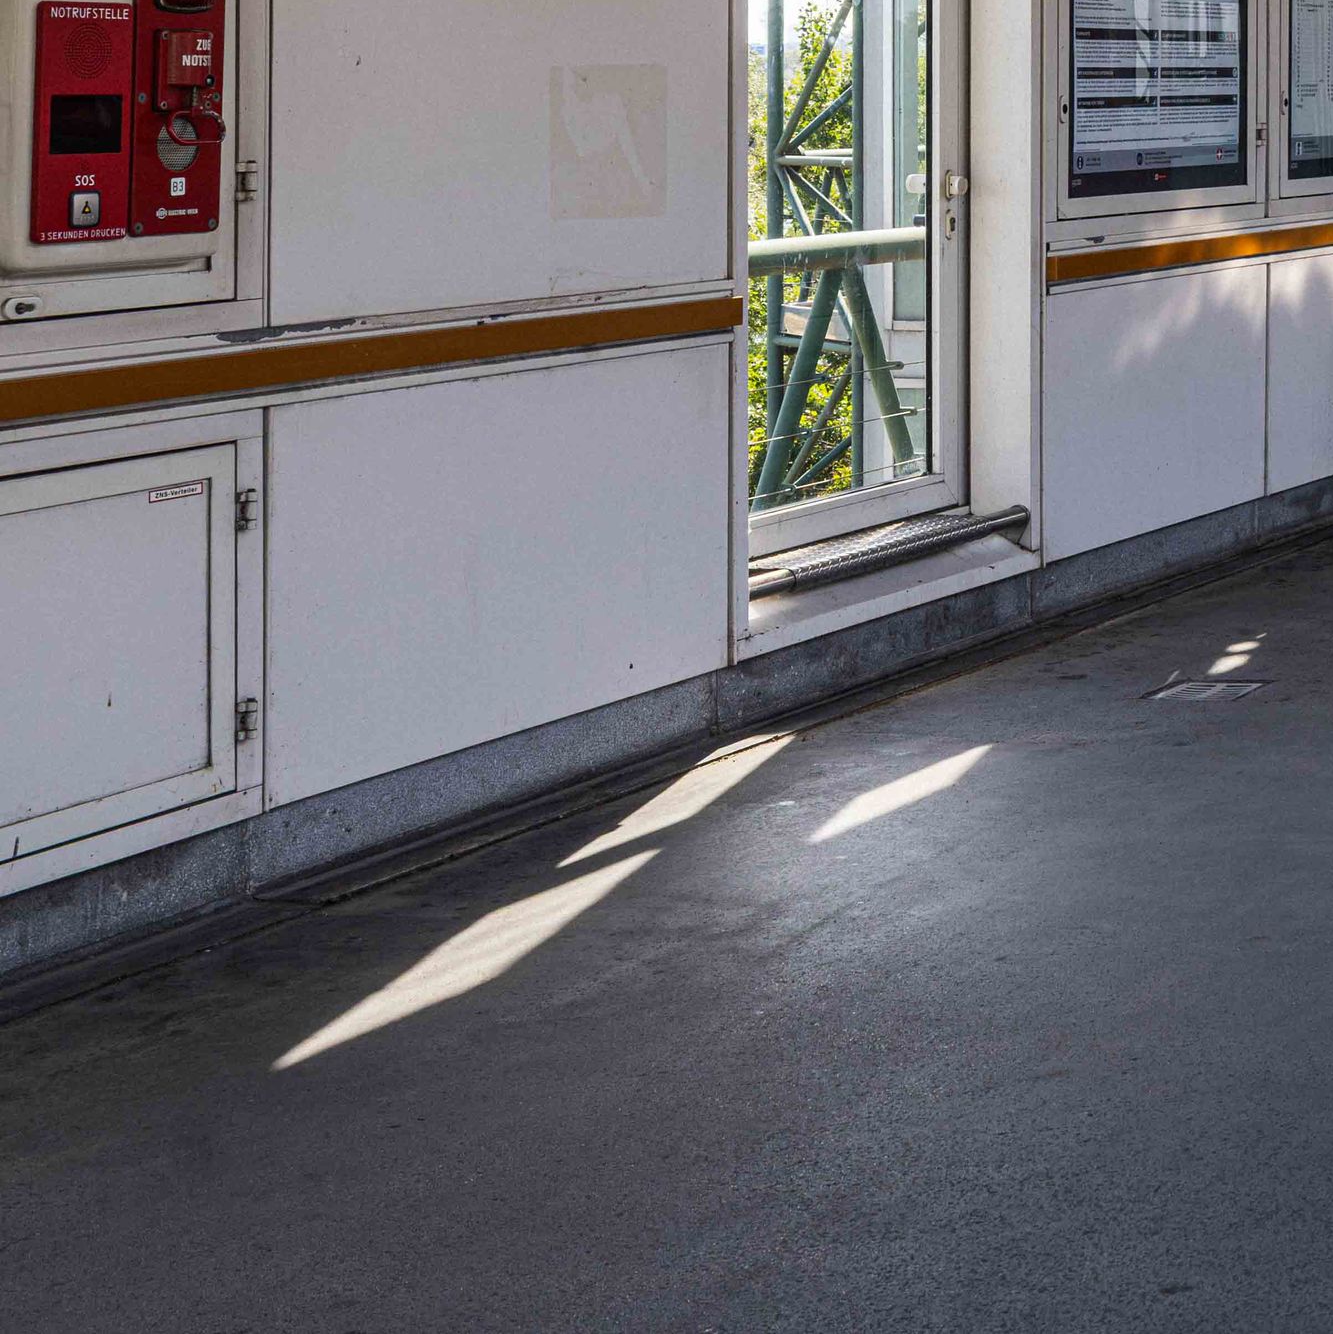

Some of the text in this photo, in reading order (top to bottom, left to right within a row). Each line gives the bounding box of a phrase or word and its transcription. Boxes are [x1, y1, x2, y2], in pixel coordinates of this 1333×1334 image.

[50, 7, 130, 20] NOTRUFSTELLE
[75, 174, 95, 187] SOS
[40, 232, 46, 241] 3
[47, 230, 89, 241] SEKUNDEN
